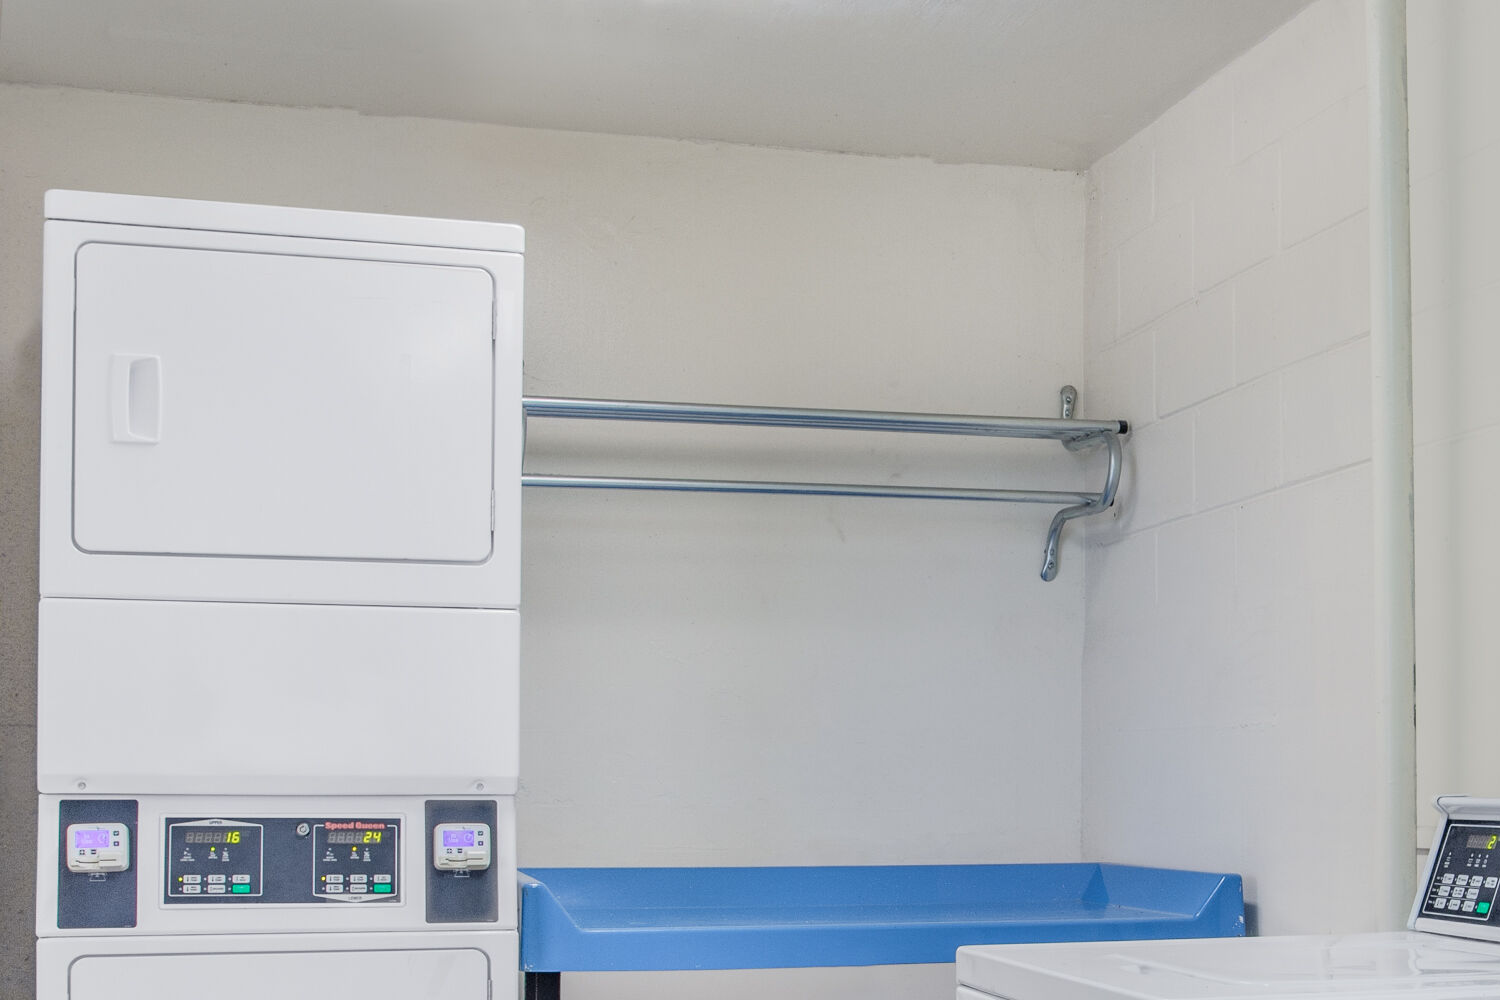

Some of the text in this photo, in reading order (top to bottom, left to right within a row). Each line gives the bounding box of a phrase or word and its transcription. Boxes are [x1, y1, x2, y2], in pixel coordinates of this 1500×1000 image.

[325, 822, 385, 830] Speed Queen
[226, 831, 240, 843] 16
[363, 831, 382, 843] 24
[1487, 835, 1497, 850] 2
